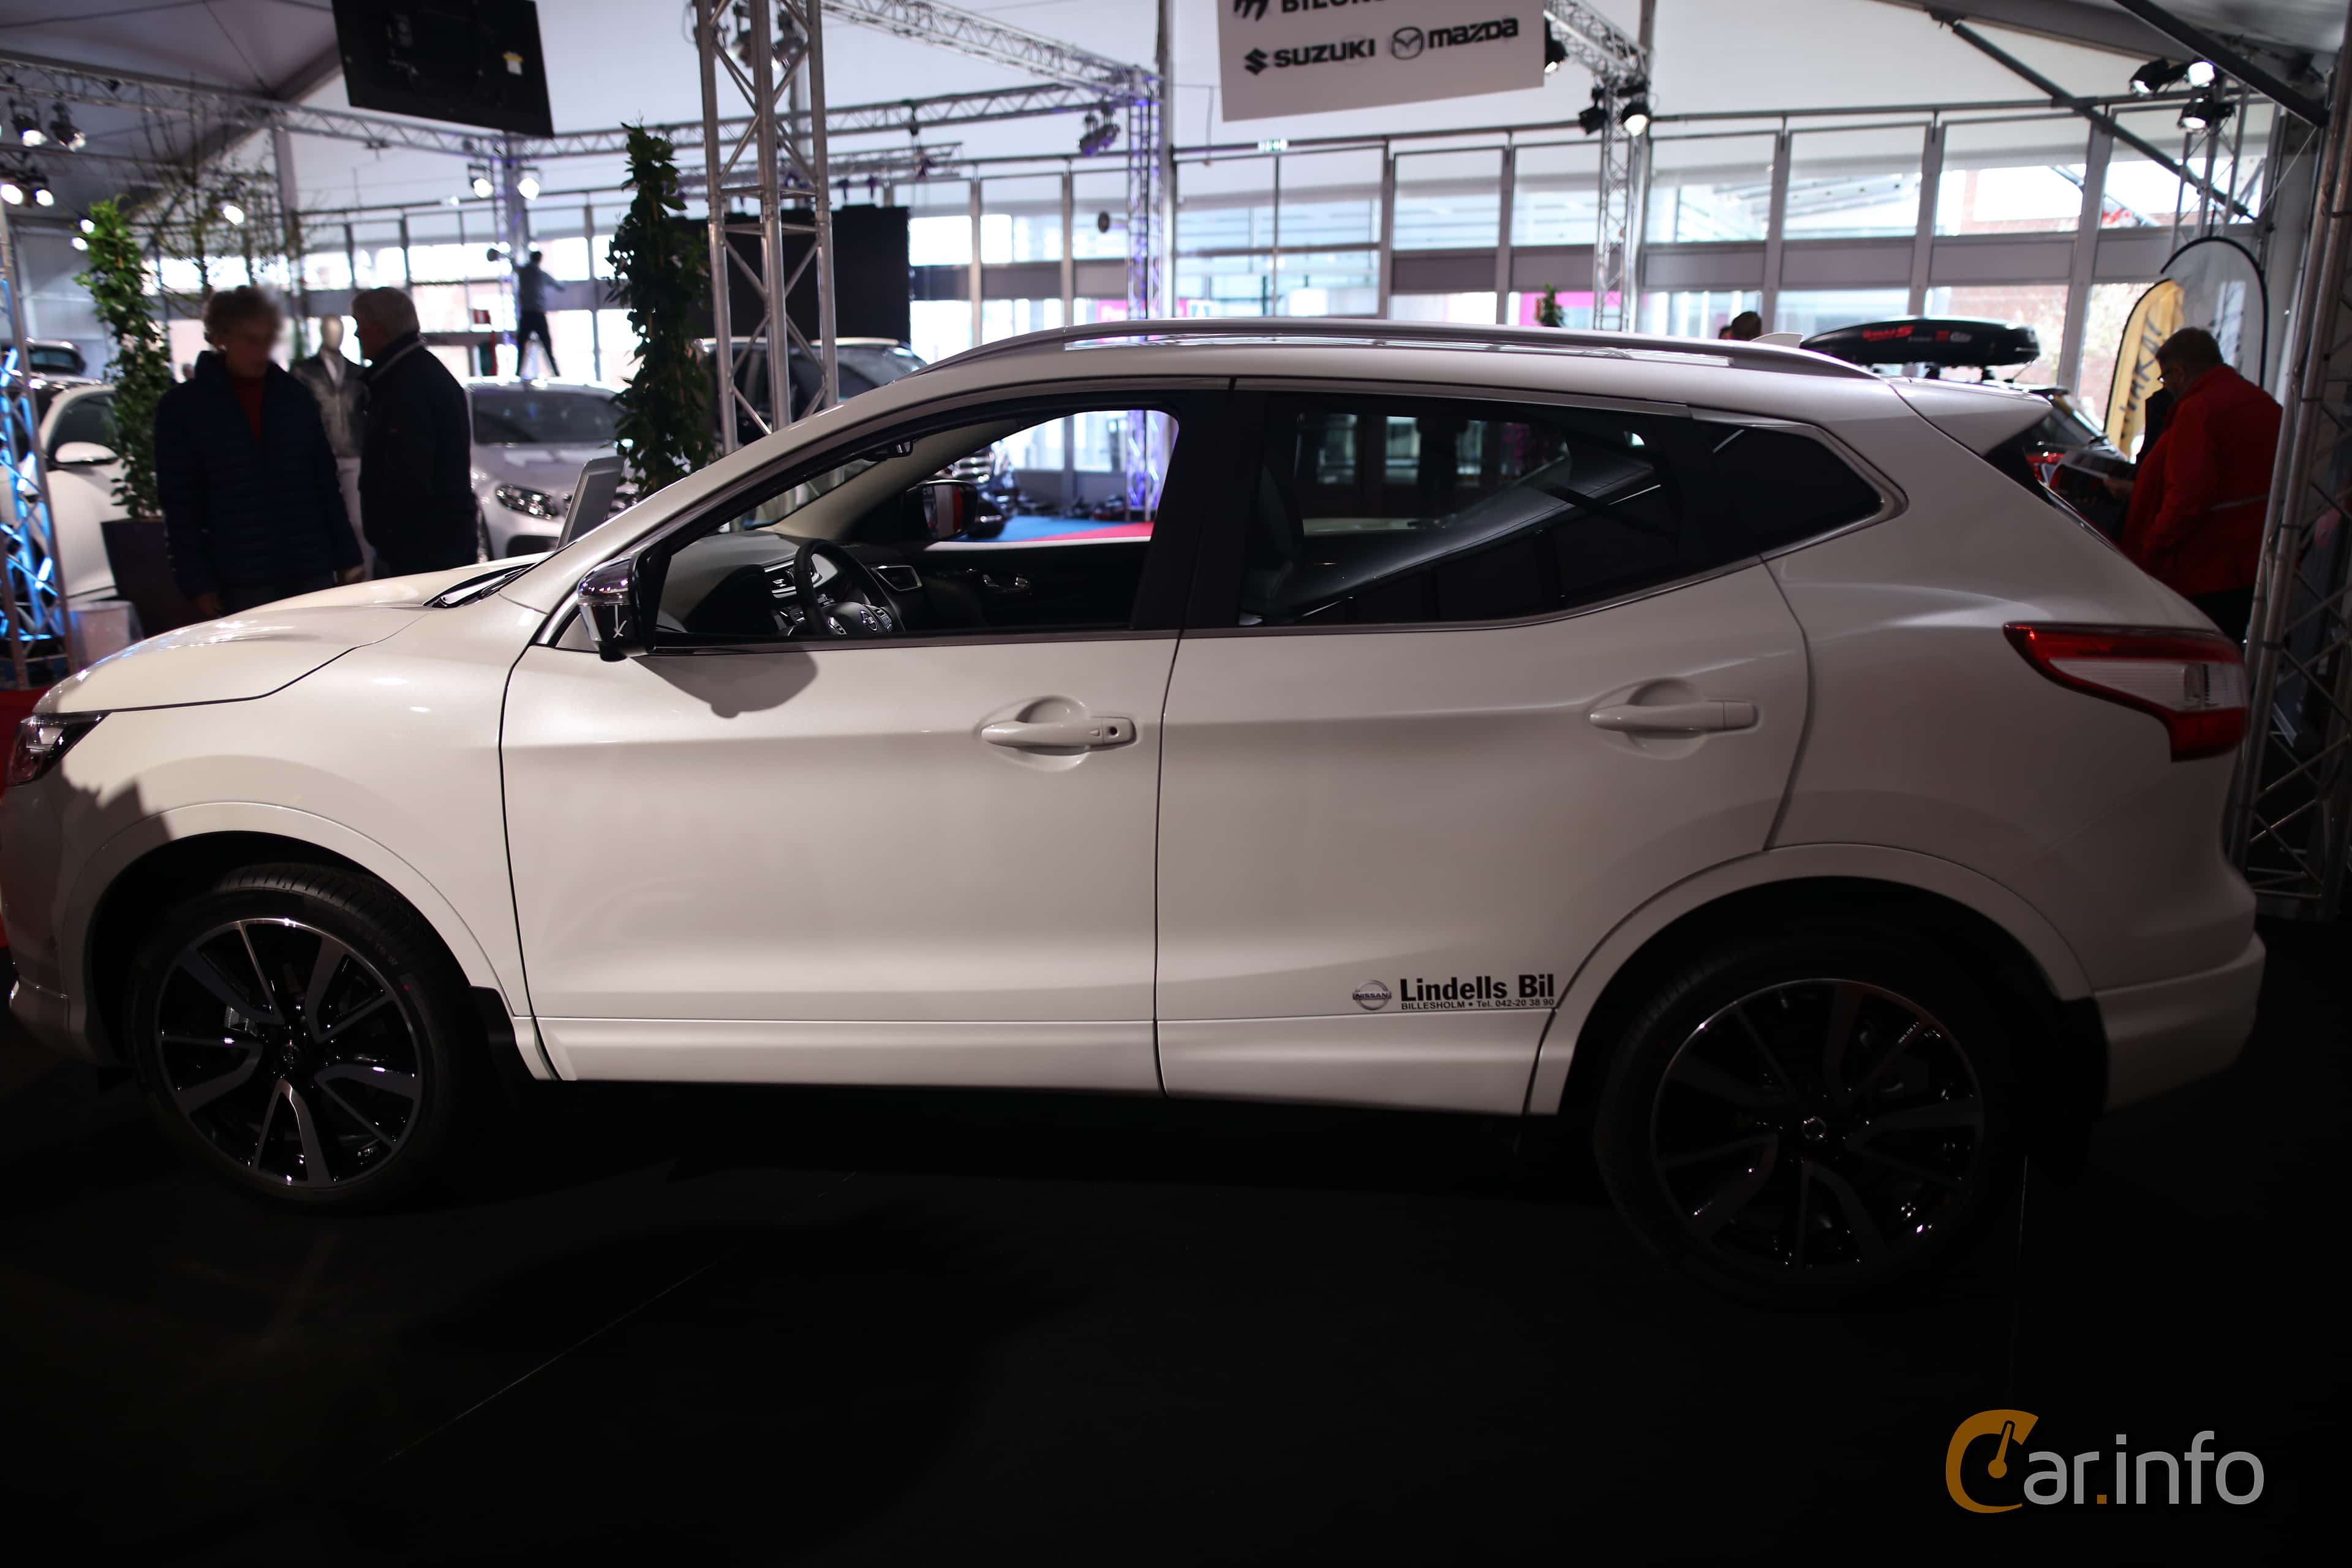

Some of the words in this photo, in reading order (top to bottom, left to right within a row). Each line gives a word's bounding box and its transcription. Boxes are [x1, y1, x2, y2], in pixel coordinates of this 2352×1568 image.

[1274, 39, 1375, 67] SUZUKI
[1400, 976, 1507, 1001] Lindells
[1519, 974, 1554, 998] Bil
[1401, 1001, 1466, 1010] BILLESHOLM
